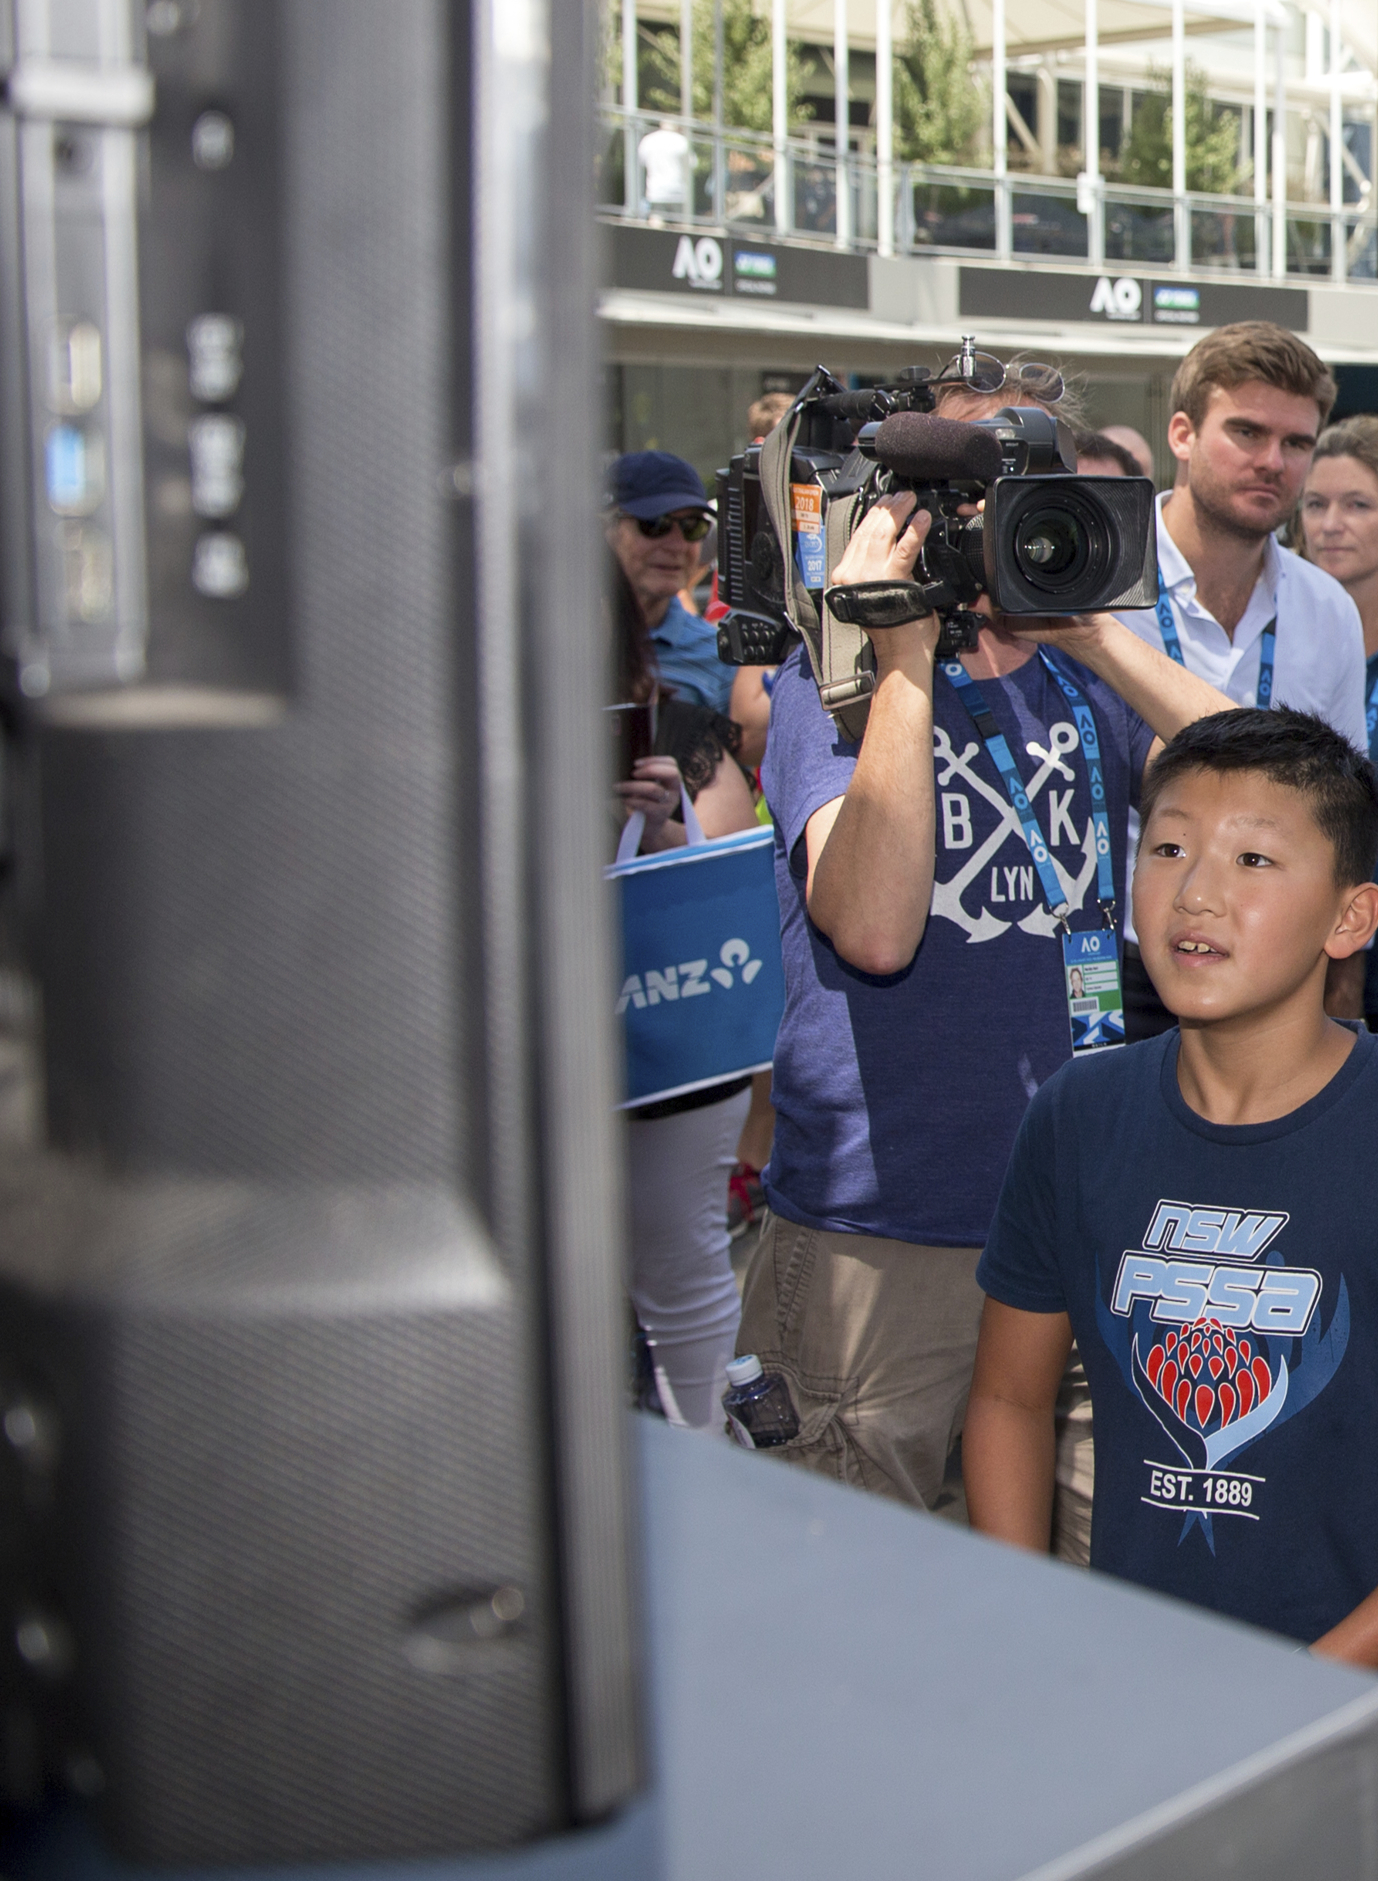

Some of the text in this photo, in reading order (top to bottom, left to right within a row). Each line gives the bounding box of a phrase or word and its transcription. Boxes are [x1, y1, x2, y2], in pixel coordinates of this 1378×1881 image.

[672, 235, 723, 280] AO
[1090, 276, 1142, 314] AO
[795, 496, 814, 511] 2018
[1259, 668, 1273, 697] AO
[1080, 713, 1097, 746] AO
[1009, 776, 1028, 810] AO
[1091, 765, 1105, 801] AO
[941, 788, 1081, 849] B K
[1030, 829, 1048, 863] AO
[1096, 820, 1110, 855] AO
[990, 865, 1034, 902] LYN
[1081, 935, 1101, 953] AO
[614, 958, 712, 1015] ANZ
[1150, 1469, 1253, 1507] EST. 1889
